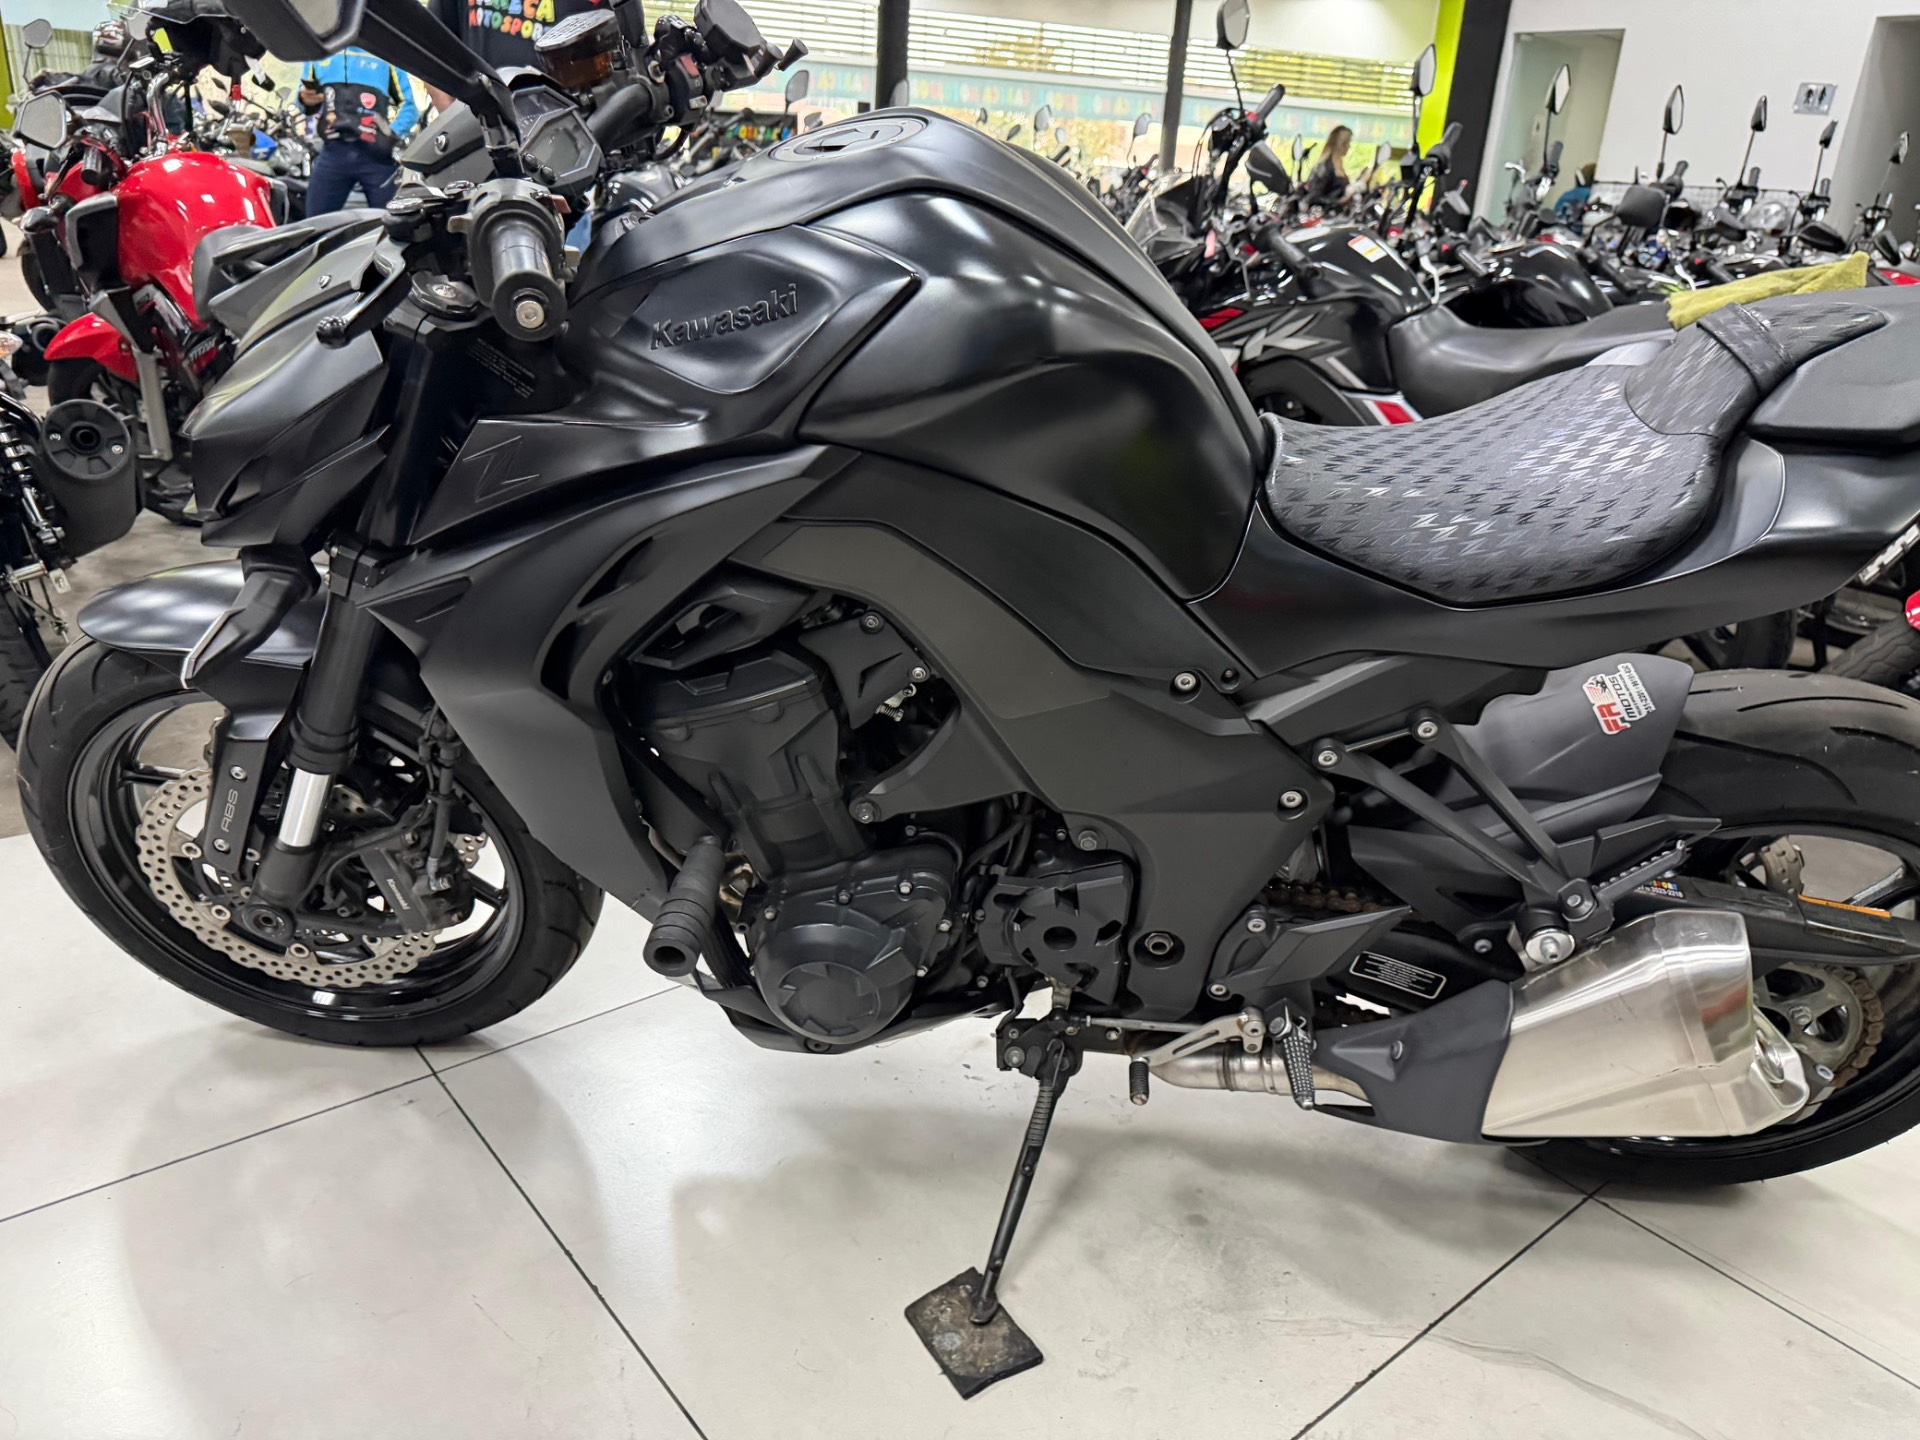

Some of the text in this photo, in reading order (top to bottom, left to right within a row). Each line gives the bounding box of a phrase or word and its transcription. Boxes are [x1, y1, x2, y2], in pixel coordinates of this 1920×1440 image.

[650, 283, 798, 351] Kawasaki
[1608, 676, 1637, 719] MOTOS
[221, 788, 239, 832] ABS
